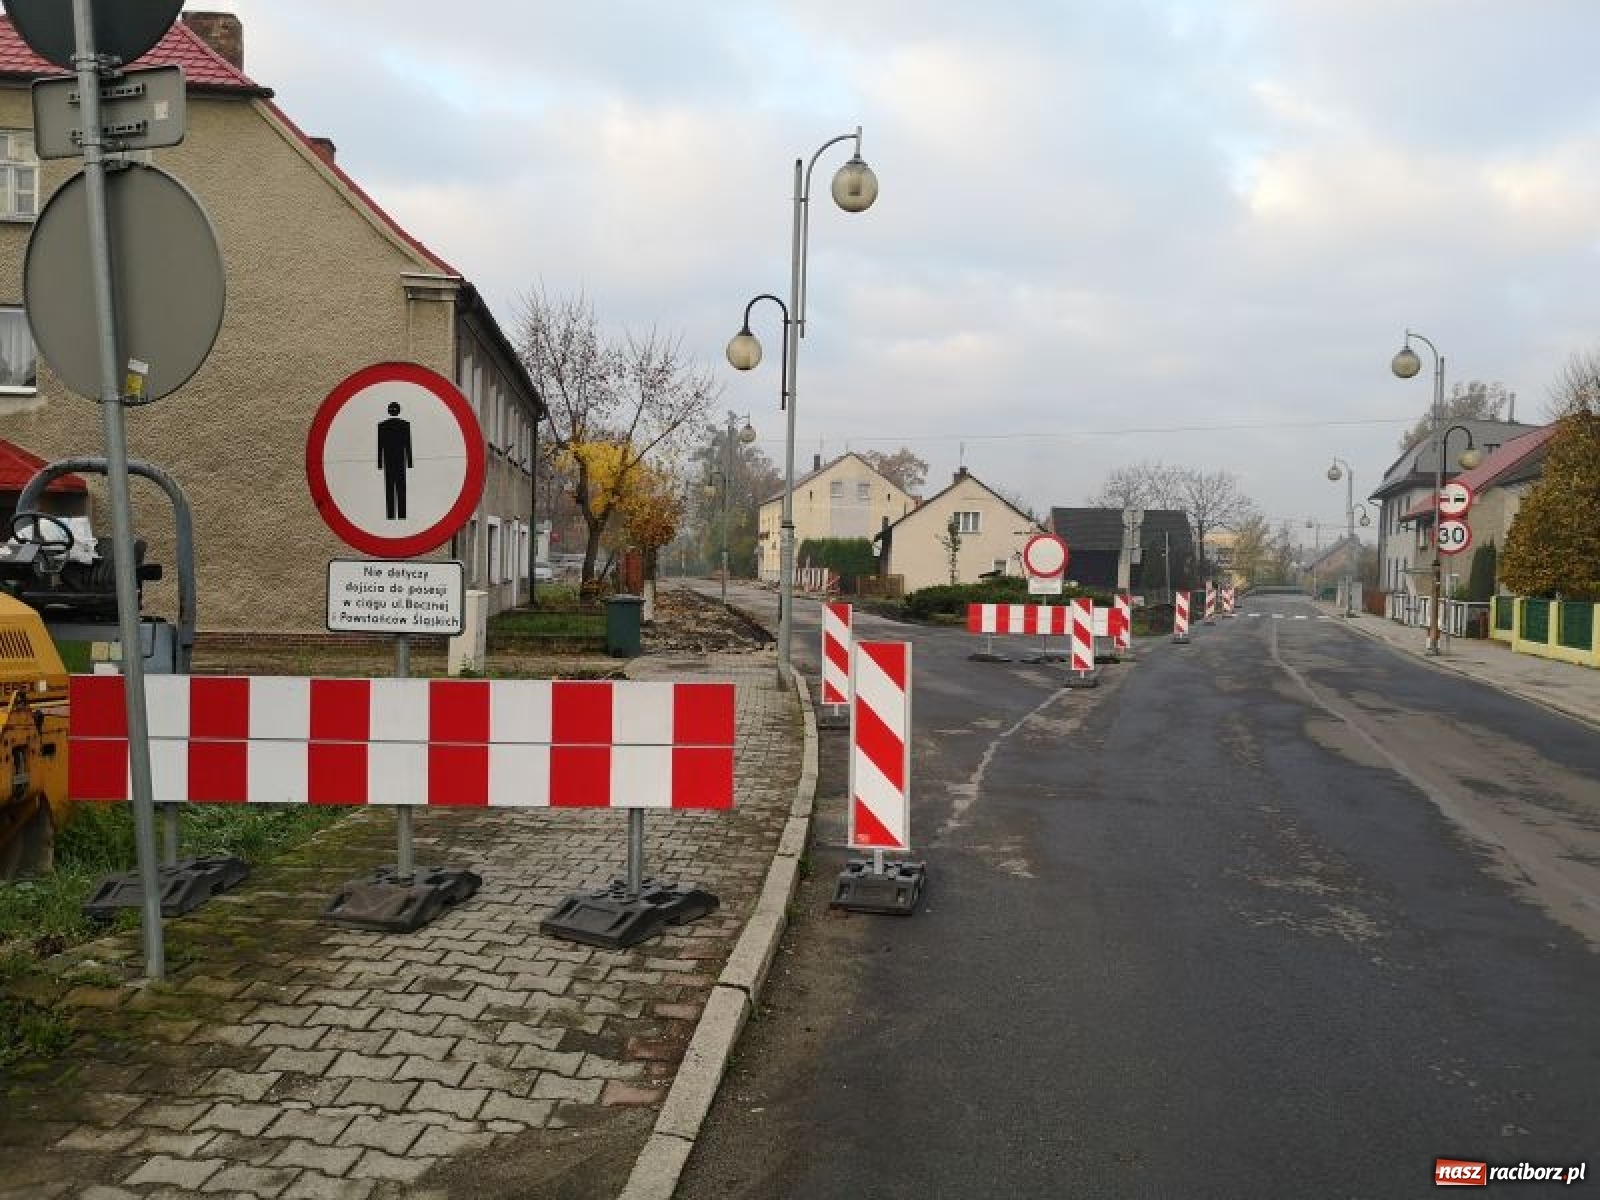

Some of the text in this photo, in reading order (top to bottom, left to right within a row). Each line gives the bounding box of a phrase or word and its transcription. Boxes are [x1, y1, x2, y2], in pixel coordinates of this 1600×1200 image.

[1438, 527, 1465, 545] 30
[363, 567, 429, 581] Nie dotyczy
[389, 583, 404, 593] do
